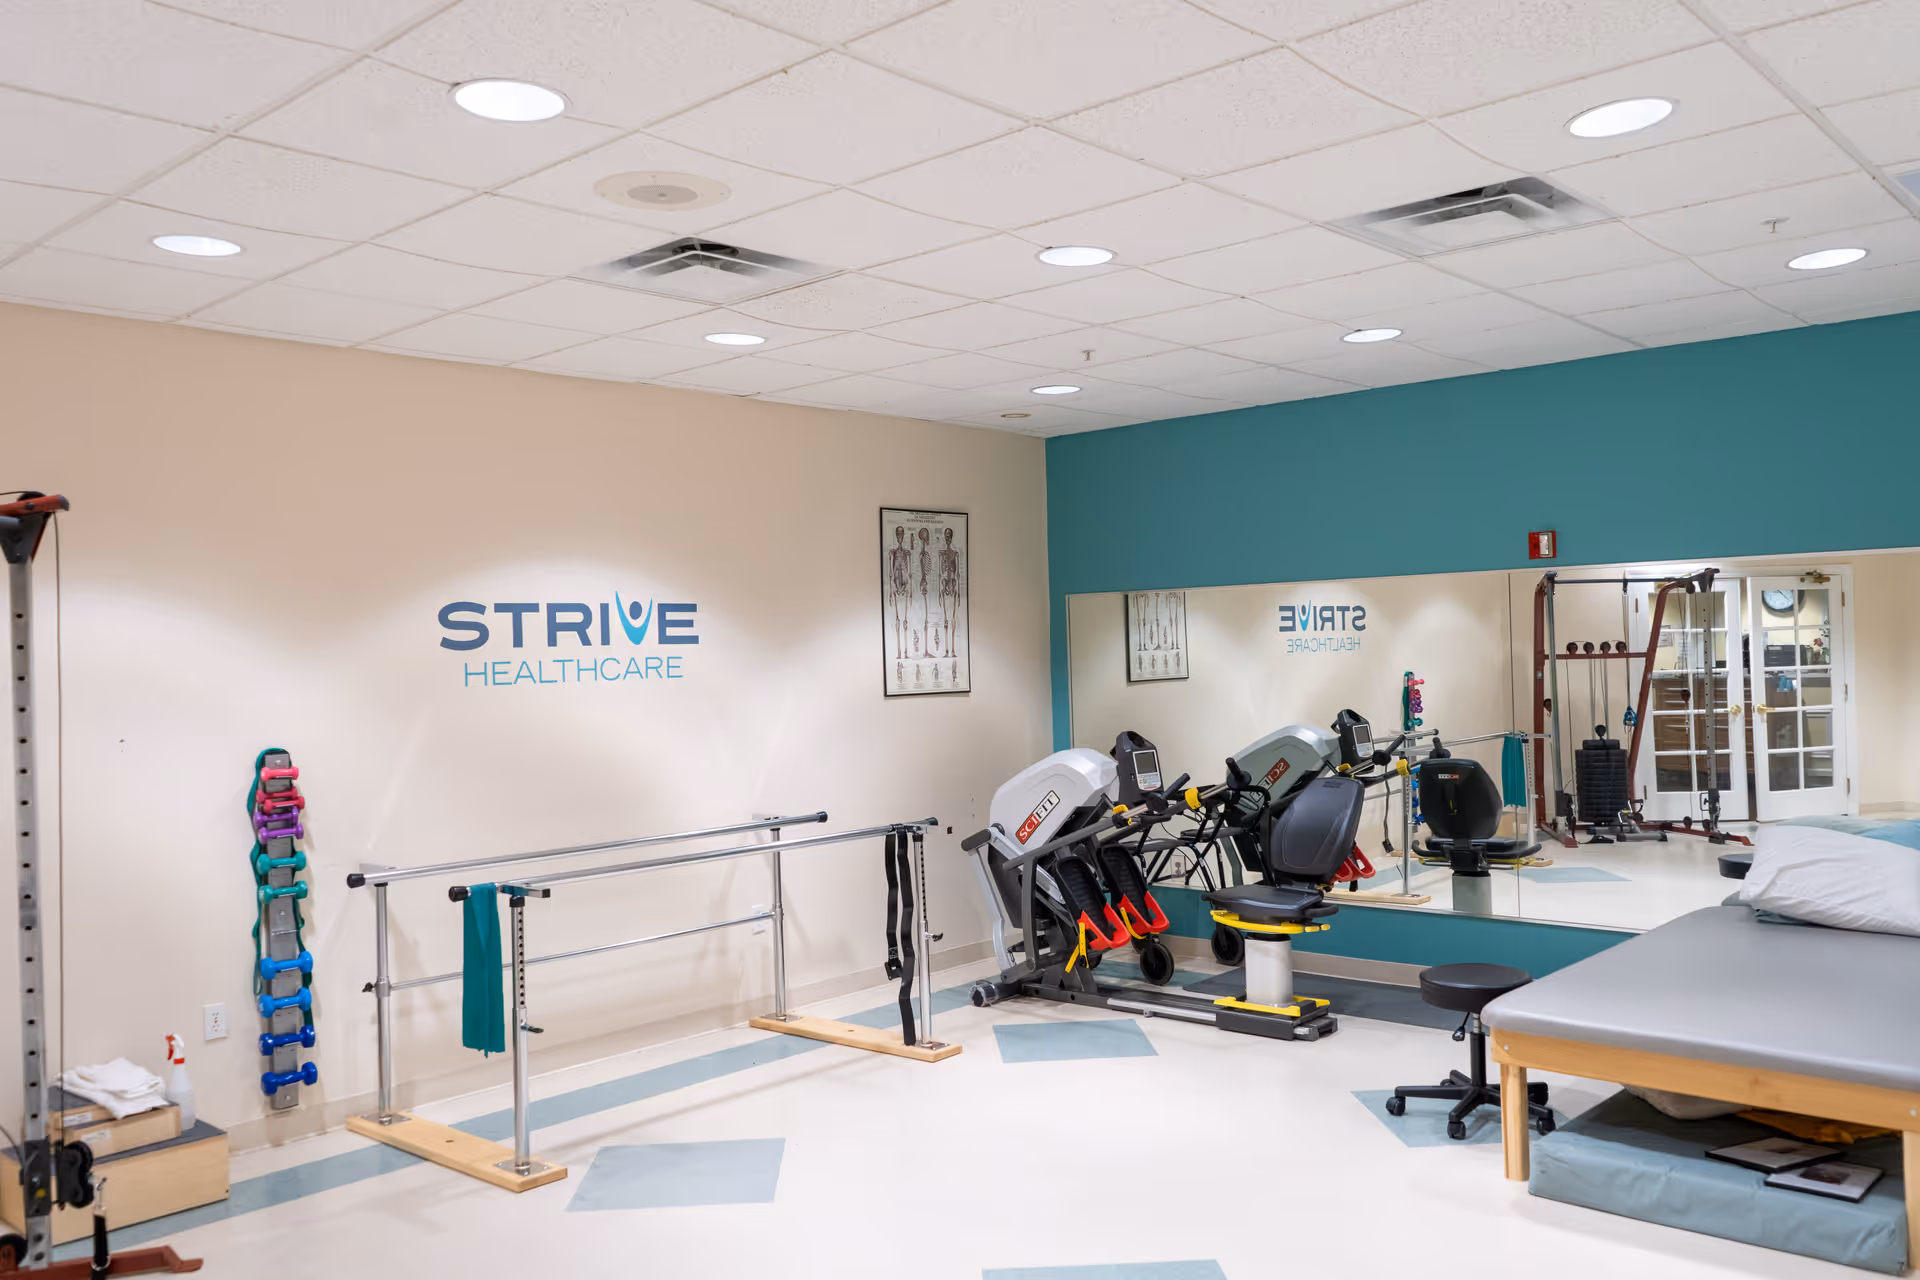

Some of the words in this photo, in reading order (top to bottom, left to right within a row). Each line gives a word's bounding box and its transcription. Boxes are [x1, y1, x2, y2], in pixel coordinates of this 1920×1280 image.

[438, 590, 699, 651] STRIVE
[464, 656, 684, 687] HEALTHCARE
[1018, 793, 1056, 841] SCIFIT
